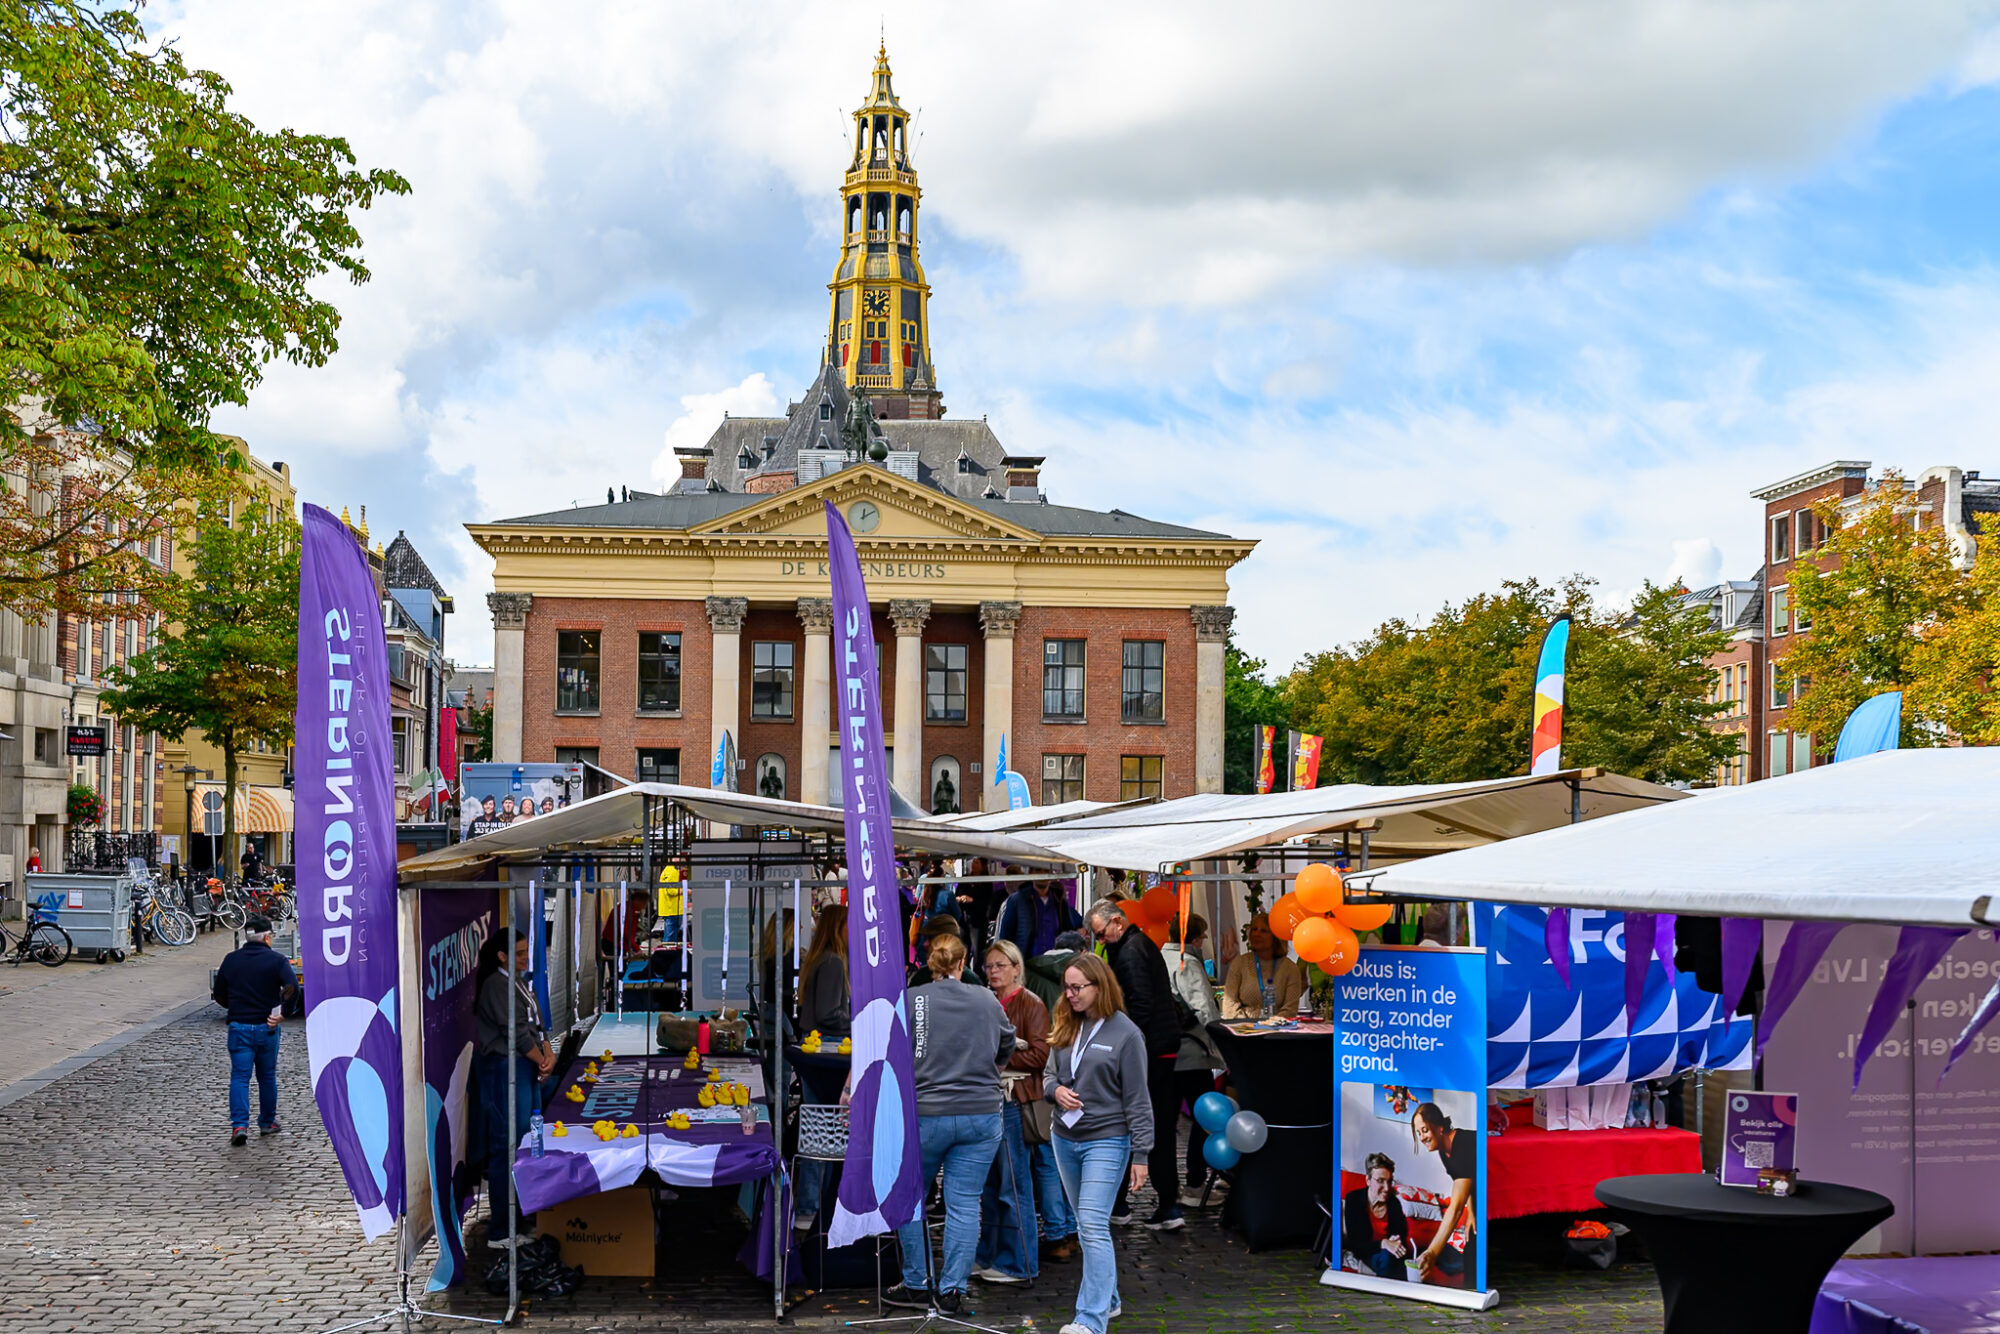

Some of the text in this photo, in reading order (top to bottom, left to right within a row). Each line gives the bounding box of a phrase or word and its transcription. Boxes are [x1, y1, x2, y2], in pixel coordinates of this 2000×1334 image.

[782, 561, 945, 578] DE KENBEURS
[1347, 958, 1394, 979] okus
[1398, 960, 1417, 980] is:
[1341, 982, 1456, 1005] werken in de
[914, 995, 925, 1059] STERINORD
[1341, 1008, 1453, 1029] zorg, zonder
[1340, 1030, 1444, 1053] zorgachter-
[1340, 1053, 1399, 1073] grond.
[1740, 1119, 1784, 1129] Bekijk alle
